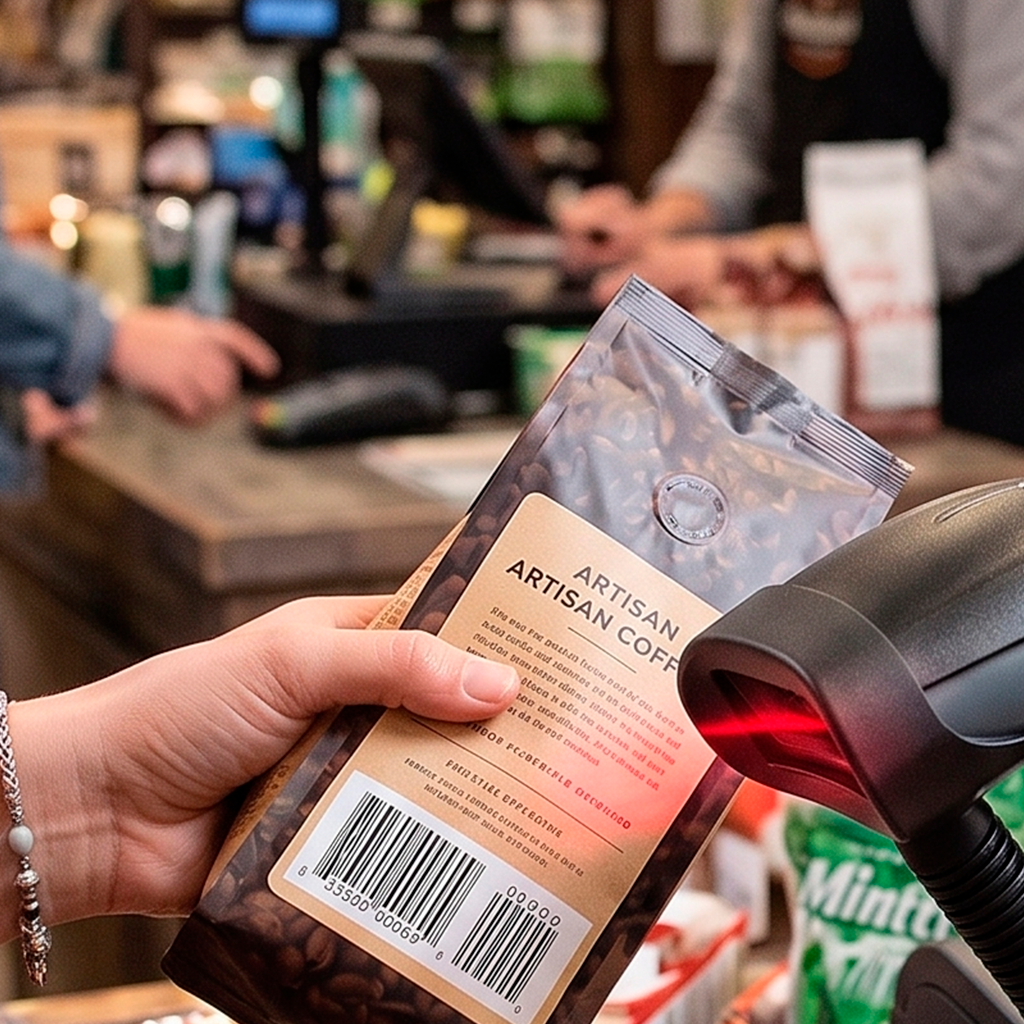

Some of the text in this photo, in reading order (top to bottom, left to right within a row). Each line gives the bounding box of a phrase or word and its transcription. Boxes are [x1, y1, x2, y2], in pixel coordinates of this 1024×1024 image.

[505, 559, 614, 631] ARTISAN
[573, 565, 680, 642] ARTISAN
[297, 865, 309, 879] 6
